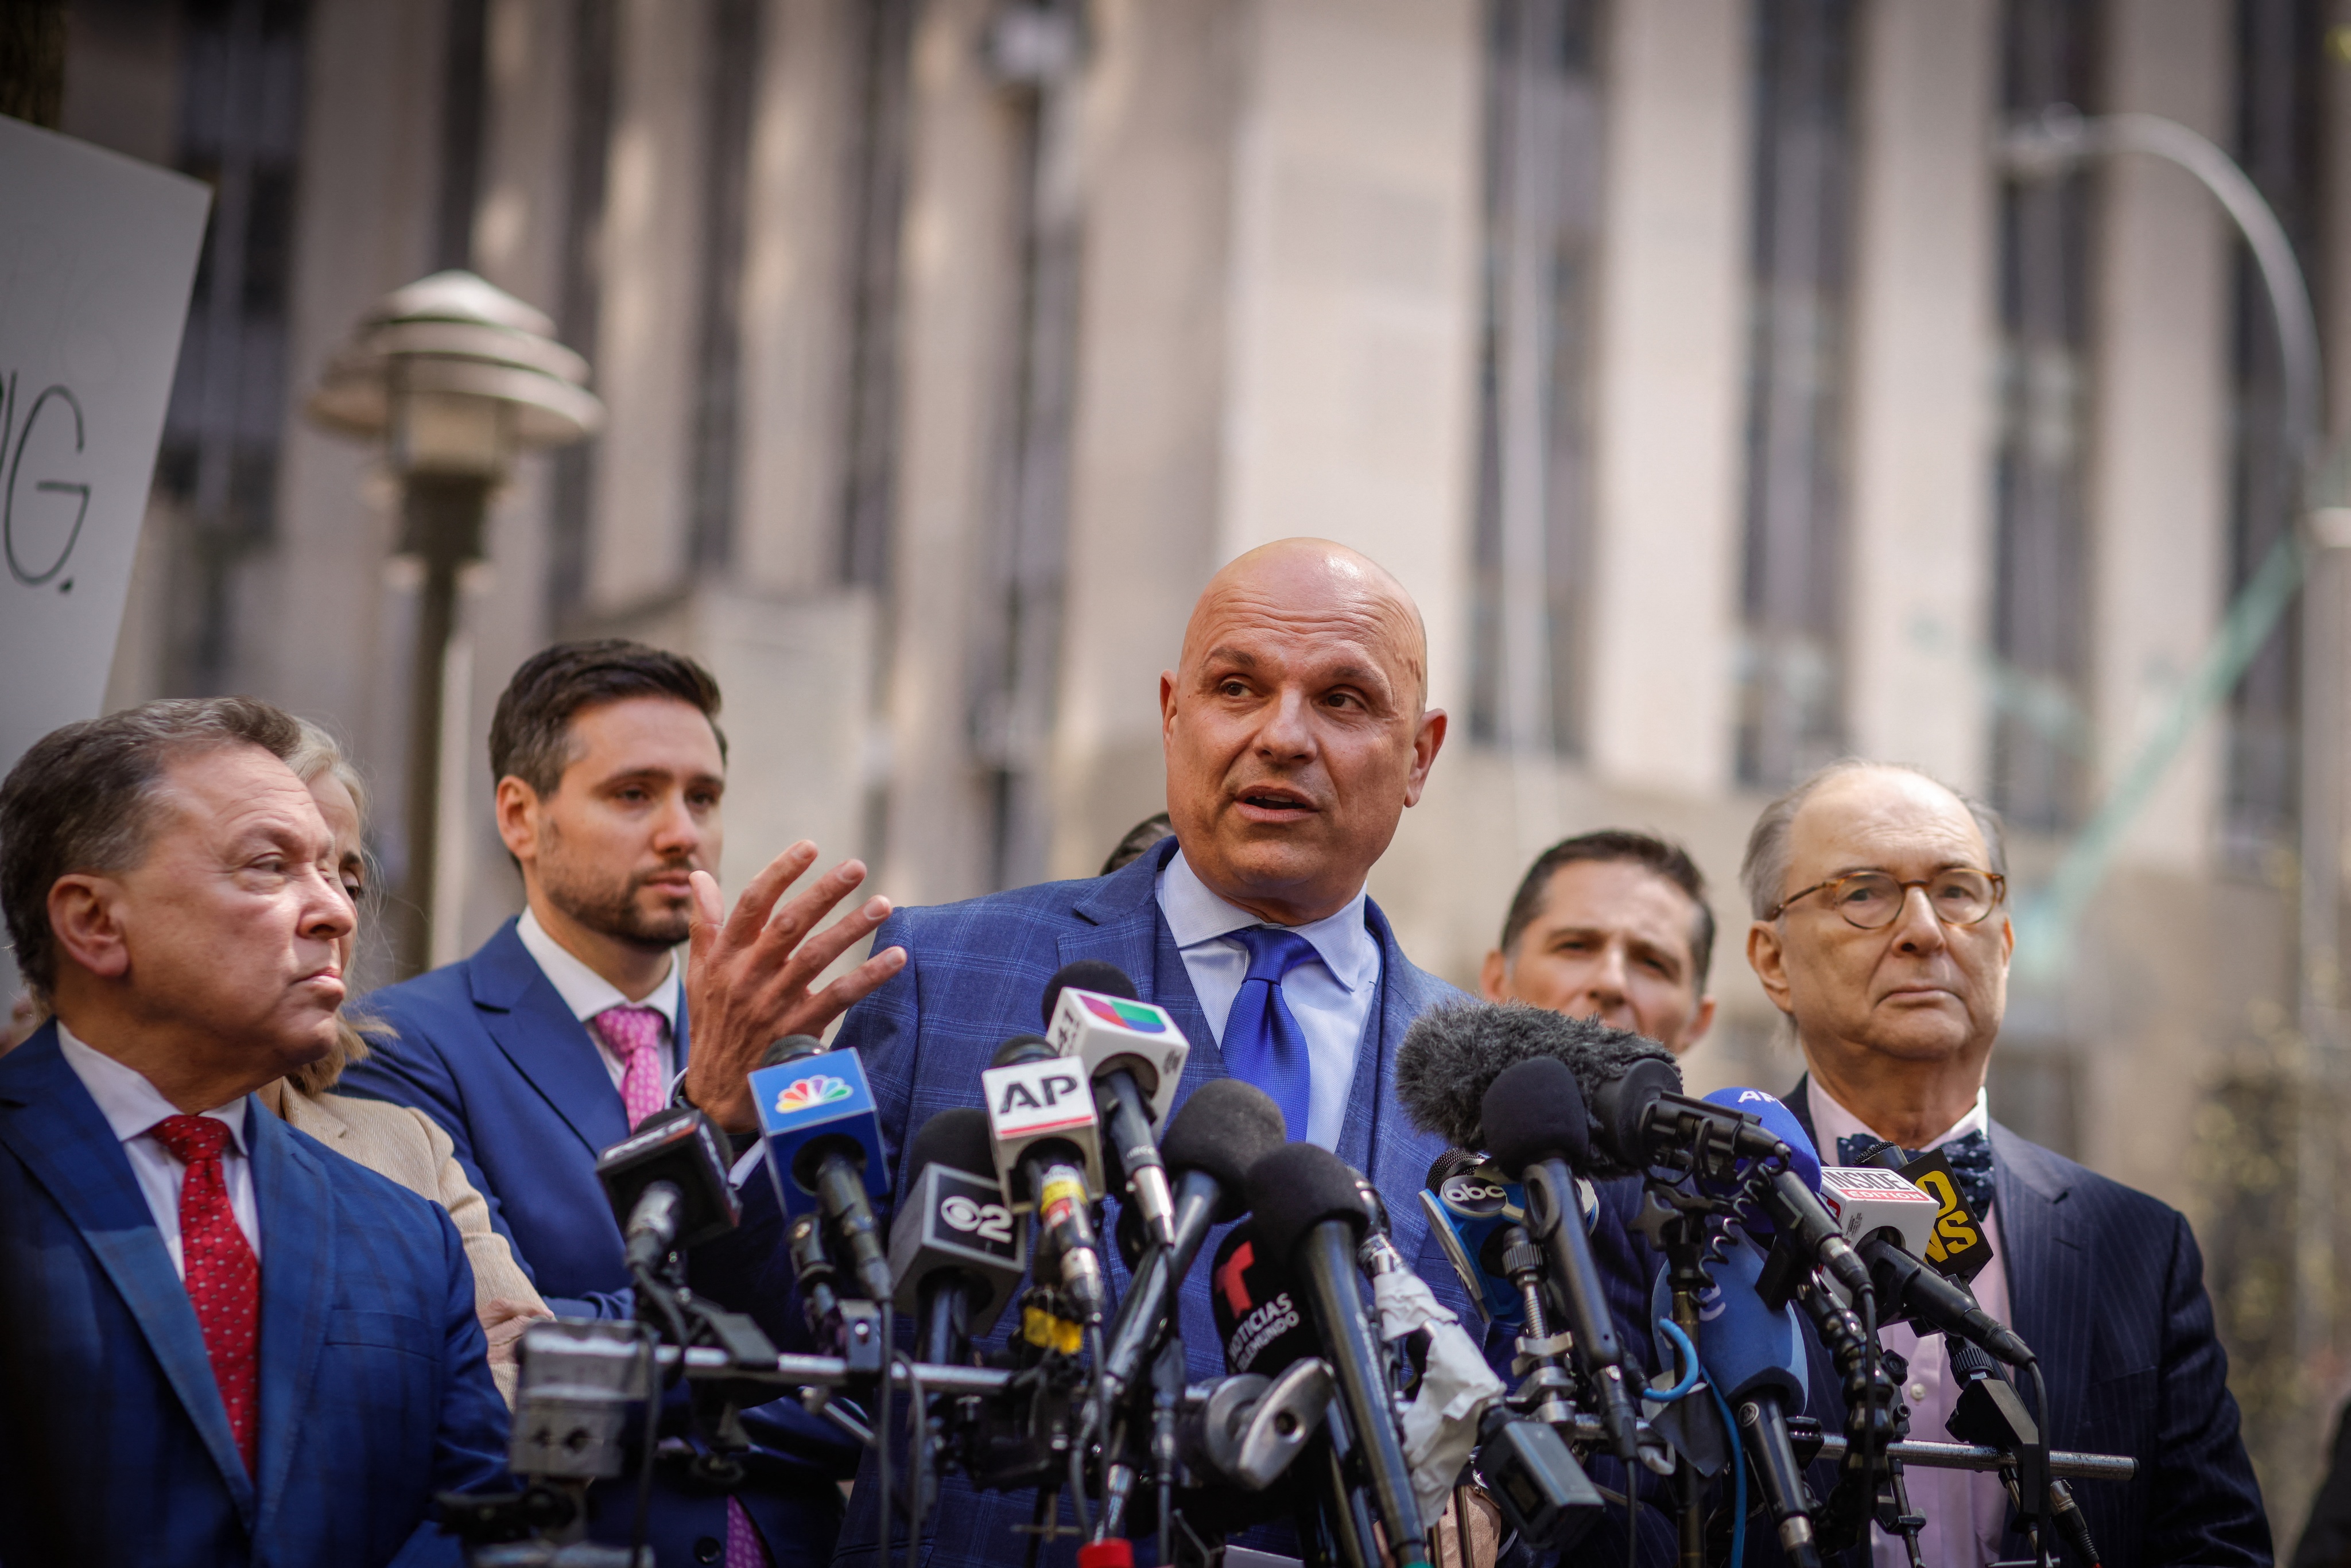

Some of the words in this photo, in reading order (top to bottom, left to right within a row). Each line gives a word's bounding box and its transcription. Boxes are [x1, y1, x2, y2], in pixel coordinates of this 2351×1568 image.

[999, 1076, 1077, 1114] AP
[1737, 1090, 1787, 1110] AF
[1822, 1171, 1910, 1190] INSIDE
[1446, 1183, 1506, 1202] abc
[1848, 1190, 1924, 1200] EDITION
[1228, 1293, 1292, 1363] NOTICIAS
